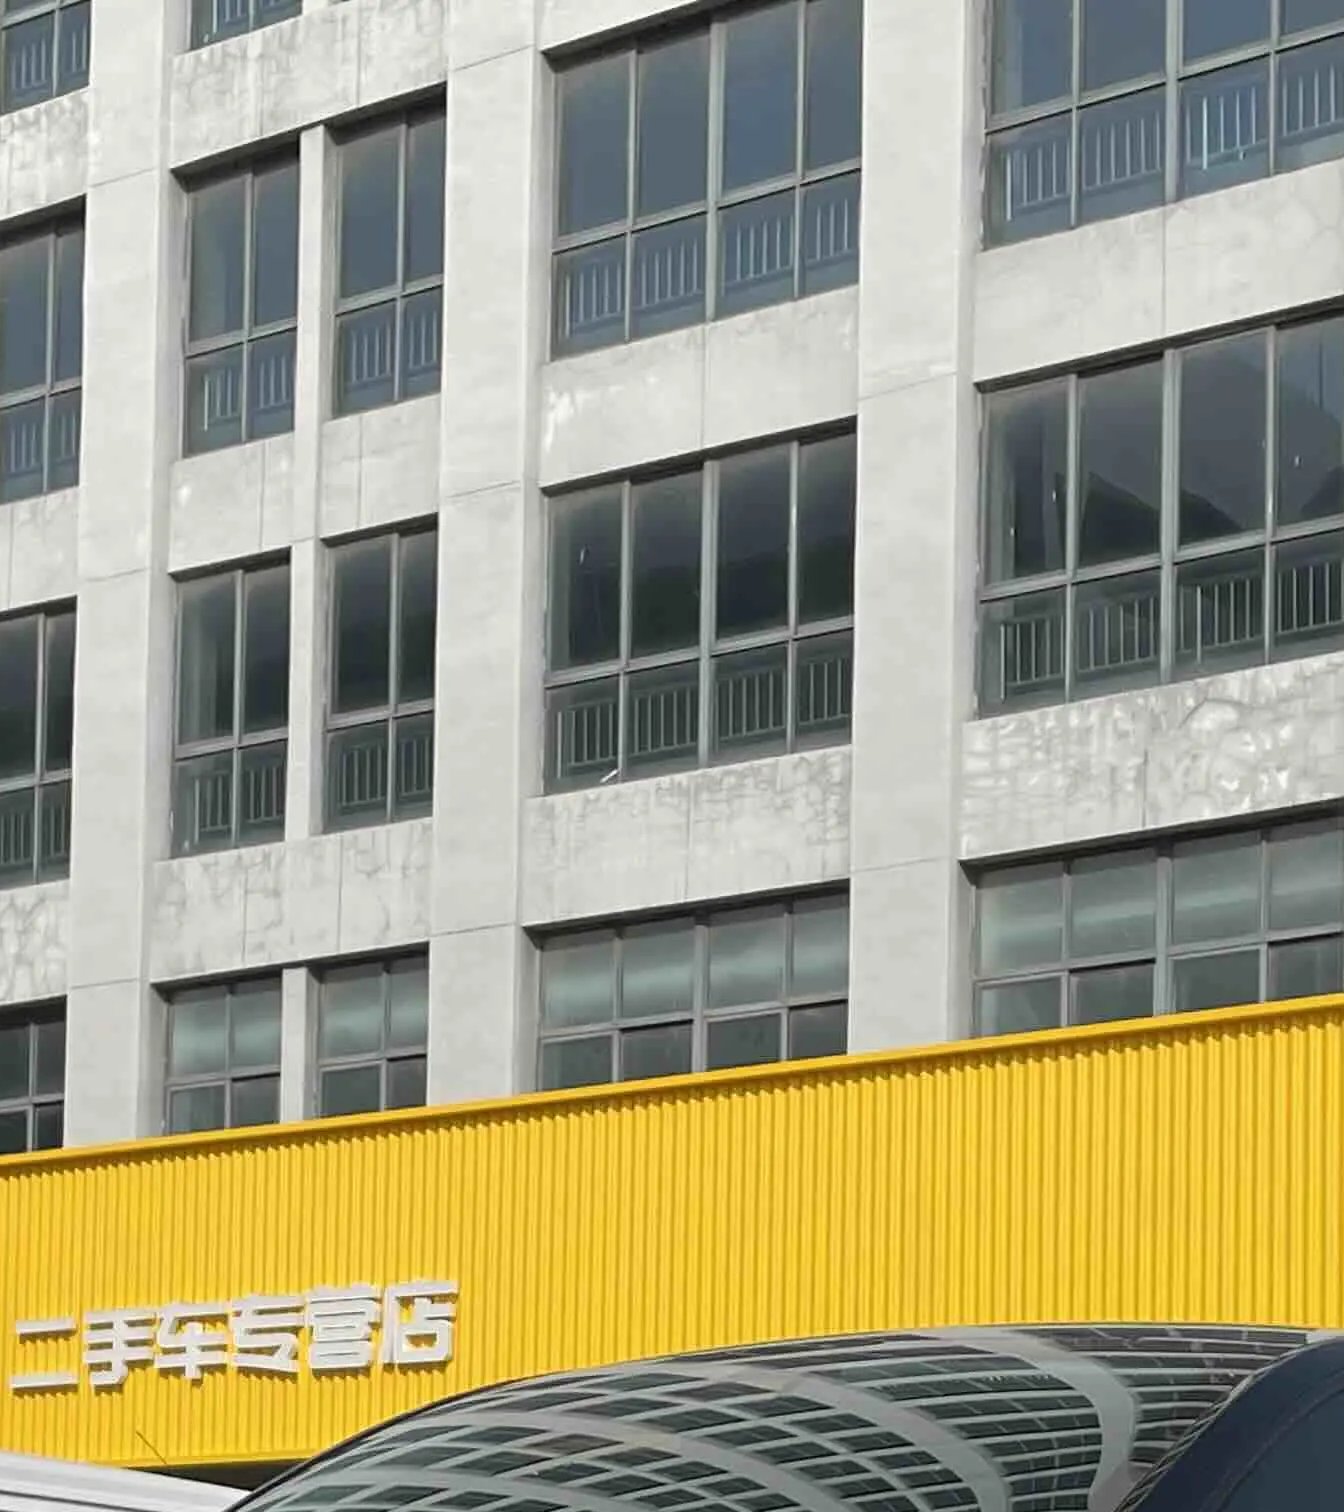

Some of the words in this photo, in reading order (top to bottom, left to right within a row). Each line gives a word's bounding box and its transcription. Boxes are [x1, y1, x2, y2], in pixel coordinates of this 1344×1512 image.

[9, 1279, 459, 1393] 二手车专营店
